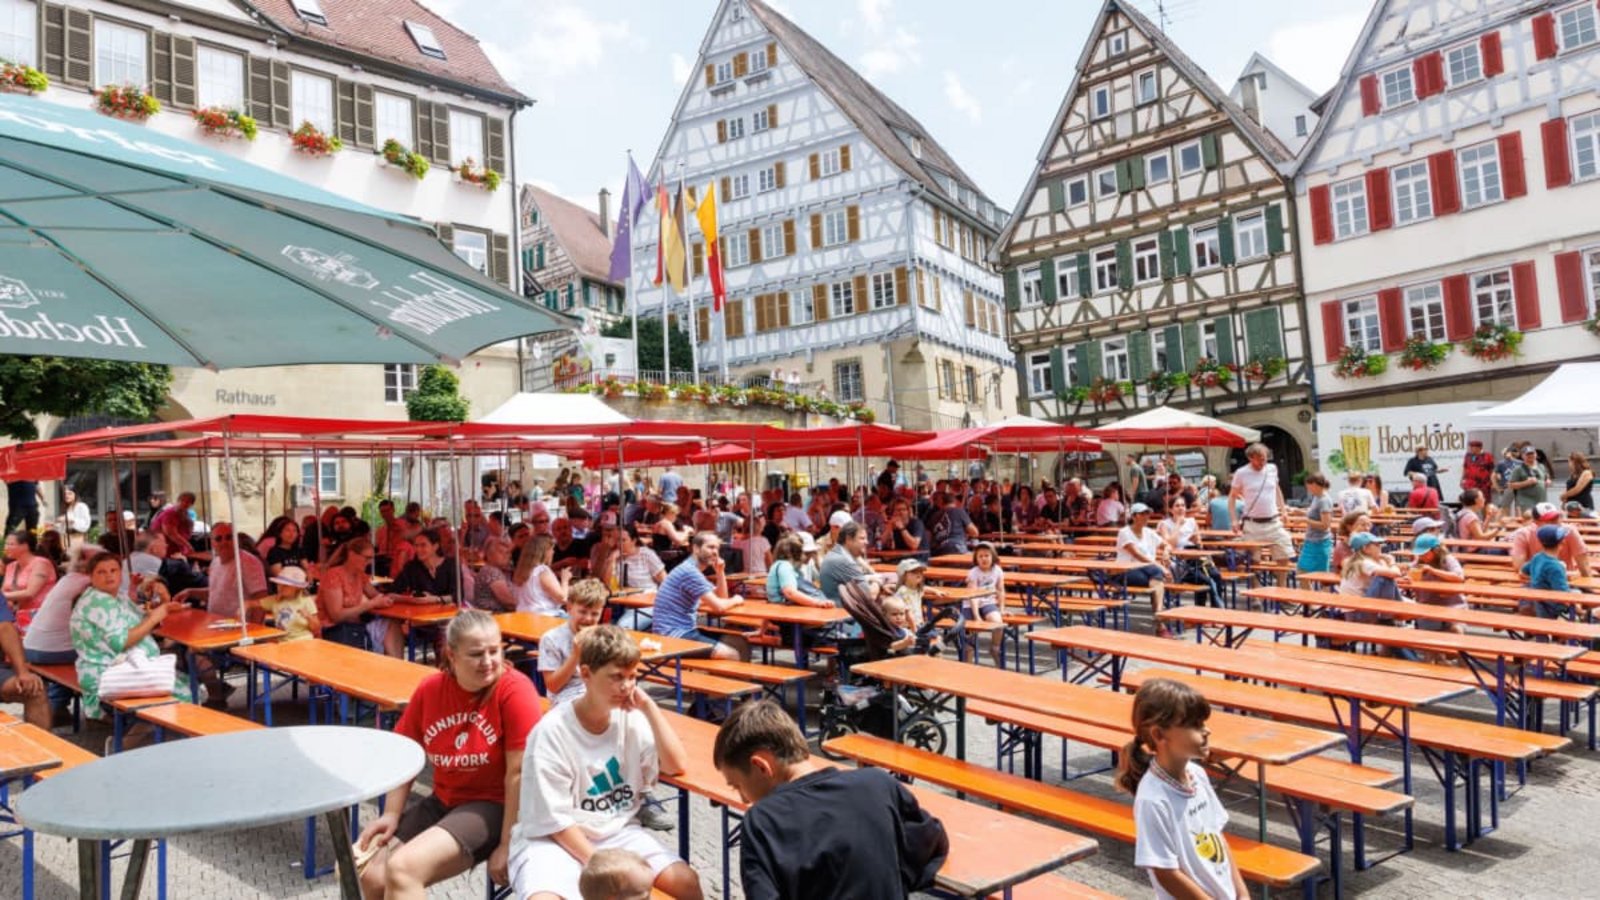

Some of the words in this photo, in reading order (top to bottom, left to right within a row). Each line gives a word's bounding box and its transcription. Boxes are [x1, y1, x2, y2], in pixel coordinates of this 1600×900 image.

[215, 388, 276, 406] Rathaus
[454, 751, 490, 767] YORK
[580, 784, 634, 813] adas
